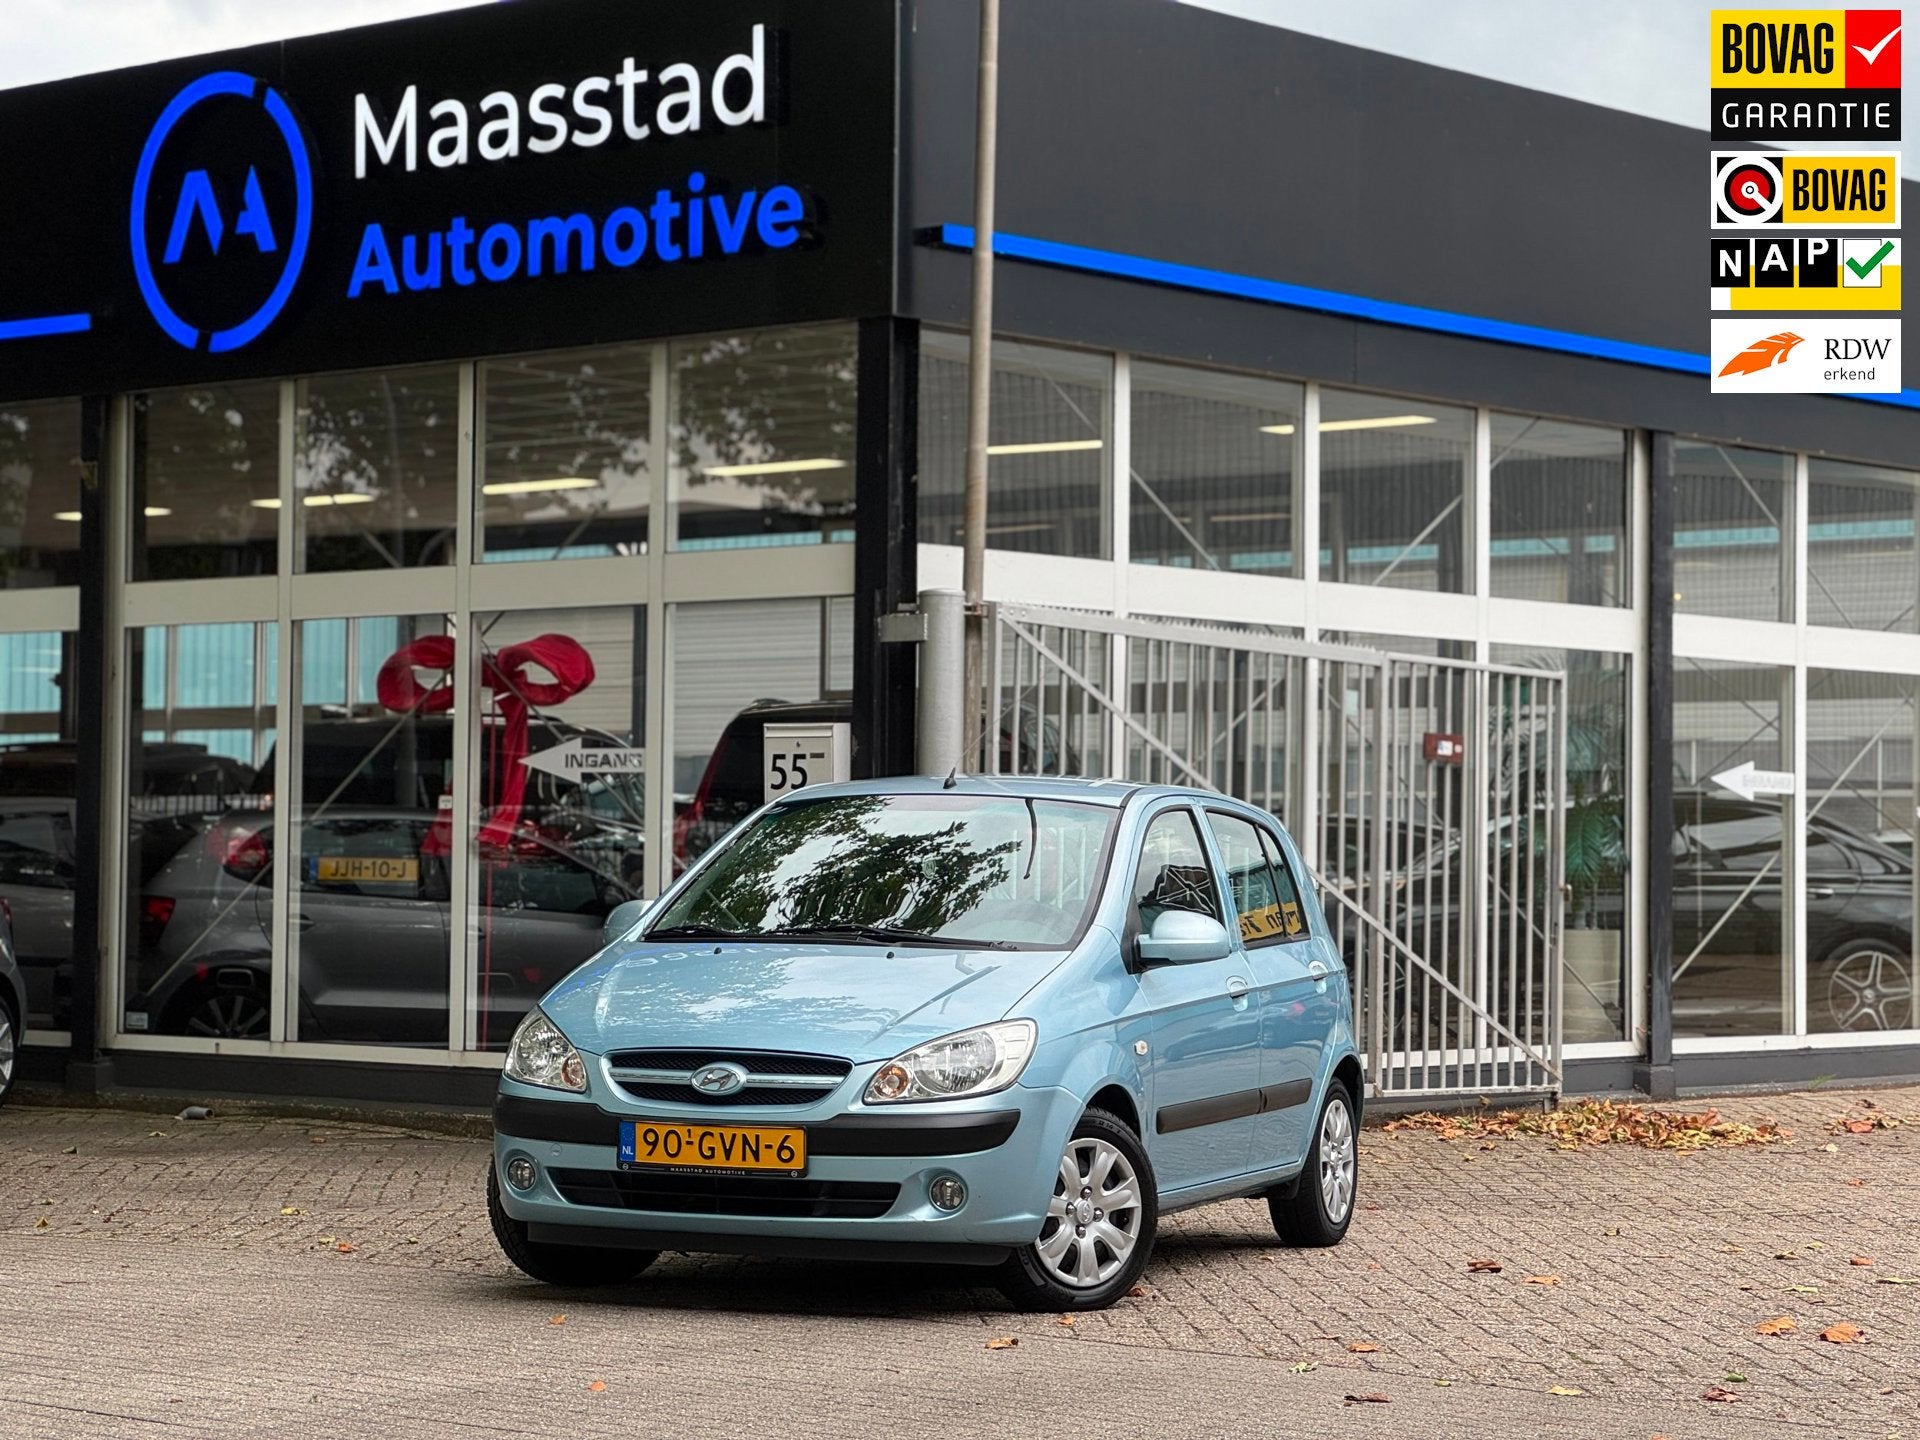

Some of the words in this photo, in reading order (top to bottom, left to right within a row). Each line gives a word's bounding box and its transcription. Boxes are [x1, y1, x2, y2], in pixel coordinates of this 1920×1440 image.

[353, 23, 767, 180] Maasstad
[346, 171, 804, 299] Automotive
[565, 753, 642, 768] INGANG
[330, 860, 406, 878] JJH-10-J
[622, 1145, 634, 1155] NL
[642, 1128, 796, 1164] 90-GVN-6
